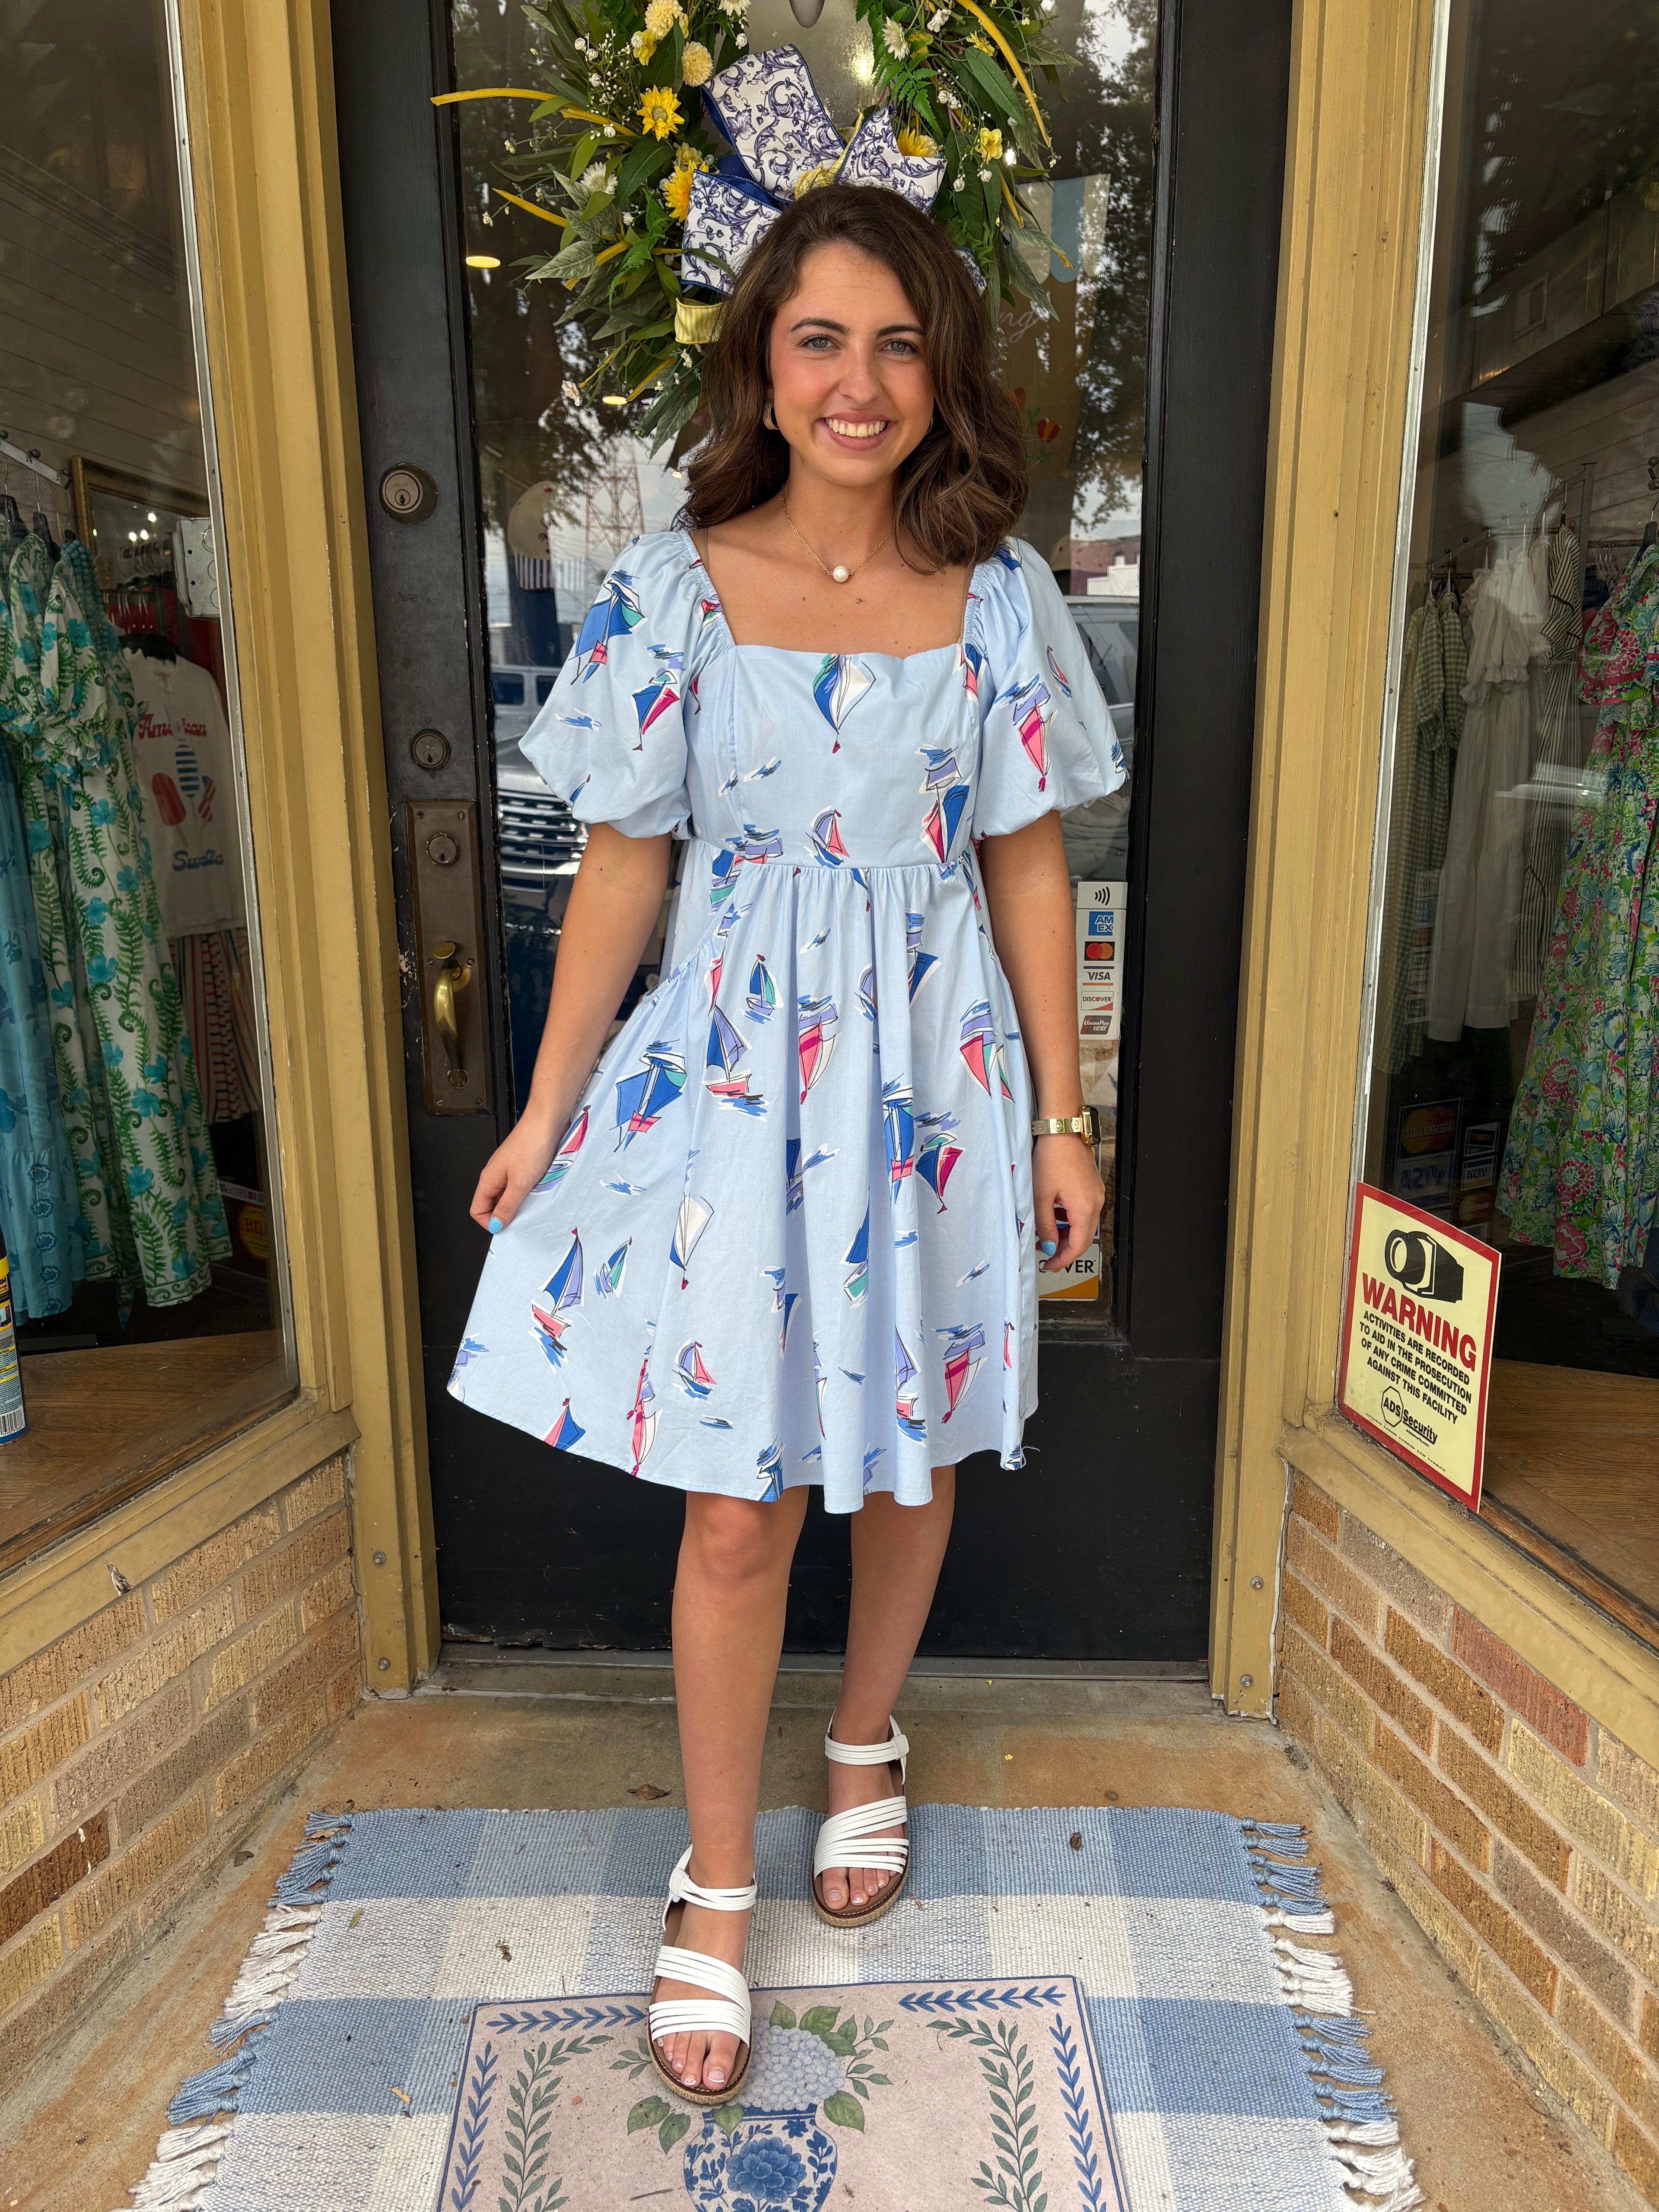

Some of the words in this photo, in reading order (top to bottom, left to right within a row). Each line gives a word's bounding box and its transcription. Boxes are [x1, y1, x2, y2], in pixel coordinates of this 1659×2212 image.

[1087, 972, 1110, 980] VISA
[1362, 1272, 1477, 1372] WARNING
[1363, 1310, 1406, 1342] ACTIVITIES
[1407, 1337, 1424, 1355] ARE
[1425, 1348, 1470, 1386] RECORDED
[1360, 1321, 1370, 1335] TO
[1372, 1330, 1386, 1344] AID
[1387, 1339, 1395, 1352] IN
[1398, 1345, 1413, 1363] THE
[1415, 1357, 1472, 1404] PROSECUTION
[1361, 1338, 1372, 1351] OF
[1373, 1345, 1390, 1362] ANY
[1391, 1356, 1417, 1381] CRIME
[1418, 1374, 1468, 1416] COMMITTED
[1367, 1356, 1401, 1385] AGAINST
[1403, 1379, 1421, 1399] THIS
[1422, 1392, 1458, 1425] FACILITY
[1383, 1397, 1401, 1417] ADS
[1403, 1409, 1438, 1444] Security
